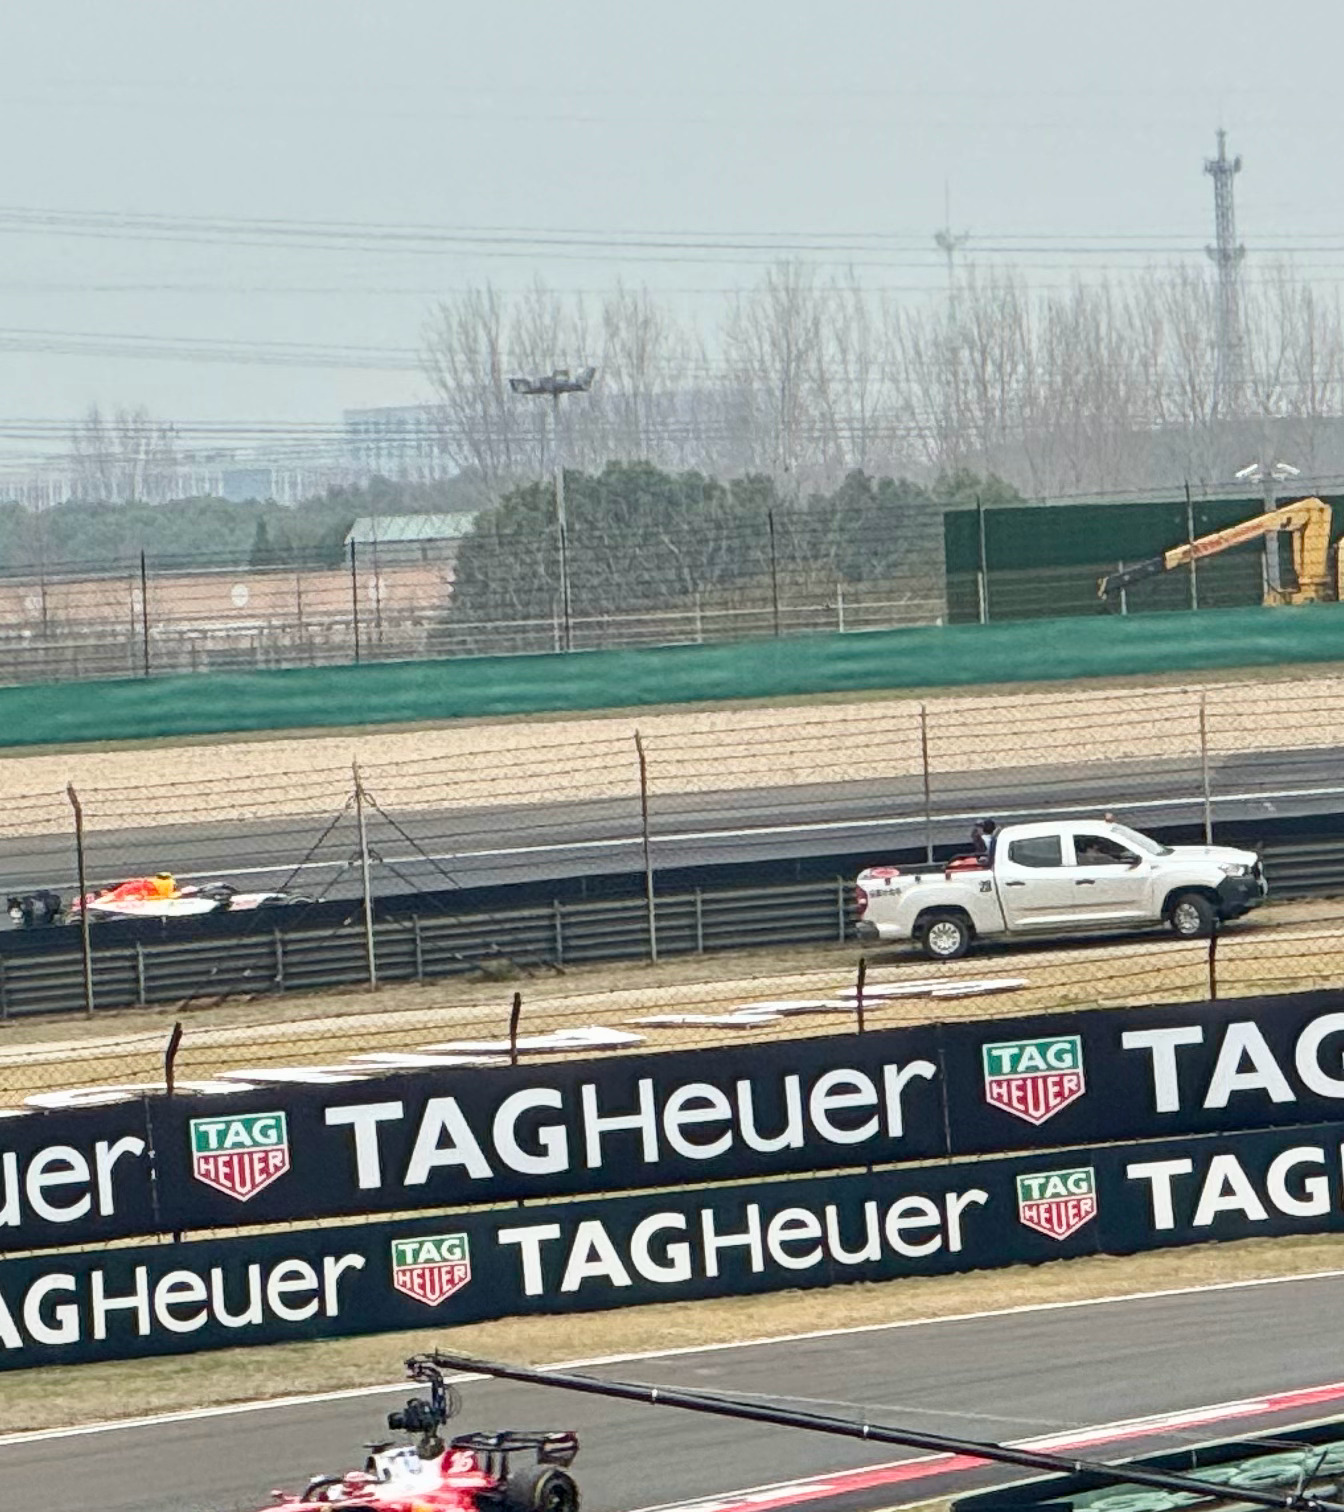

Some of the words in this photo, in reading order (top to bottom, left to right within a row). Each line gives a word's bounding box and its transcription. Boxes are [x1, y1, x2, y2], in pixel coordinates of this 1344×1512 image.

[990, 1040, 1075, 1070] TAG
[990, 1072, 1081, 1116] HEUER
[197, 1116, 277, 1145] TAG
[326, 1060, 935, 1189] TAGHeuer
[197, 1145, 285, 1193] HEUER
[1023, 1171, 1089, 1199] TAG
[1020, 1198, 1094, 1234] HEUER
[398, 1238, 464, 1264] TAG
[497, 1189, 987, 1296] TAGHeuer
[395, 1264, 468, 1300] HEUER
